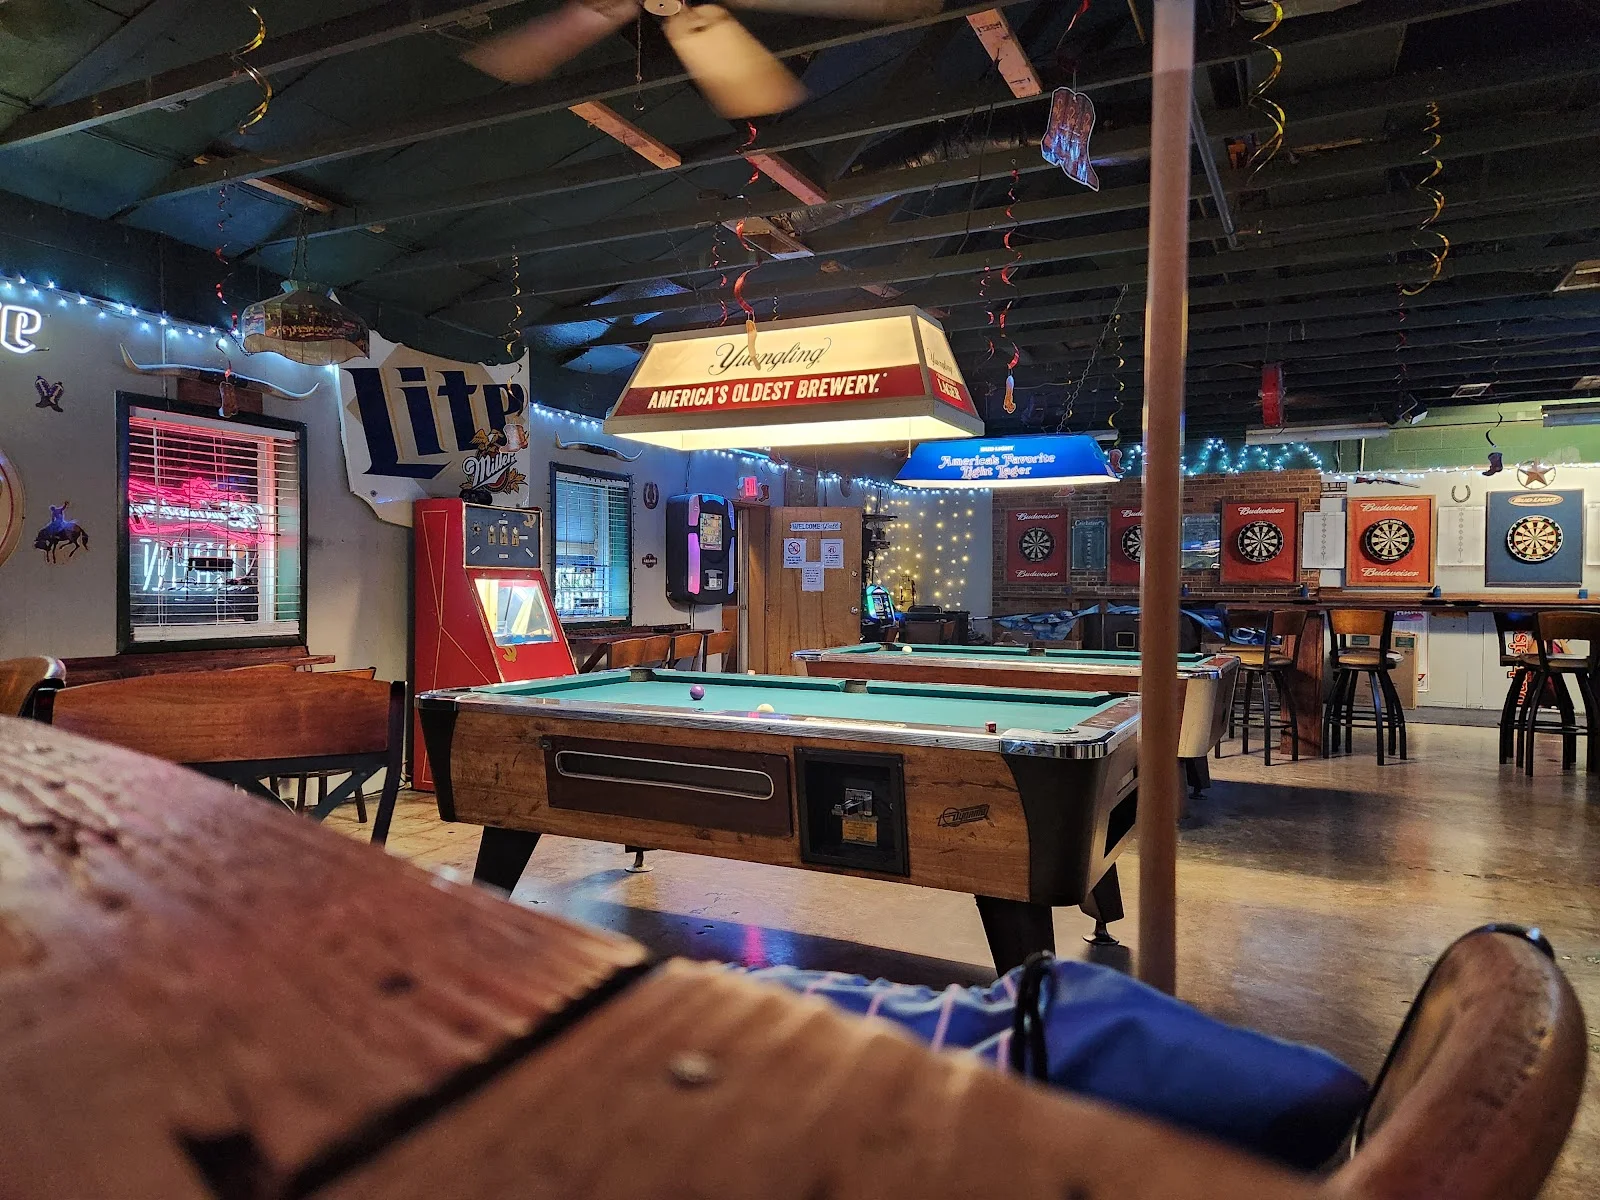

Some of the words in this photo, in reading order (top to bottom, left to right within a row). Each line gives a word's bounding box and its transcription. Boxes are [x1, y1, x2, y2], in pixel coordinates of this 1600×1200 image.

[708, 337, 831, 375] Yuengling
[647, 385, 728, 409] AMERICA'S
[732, 380, 794, 403] OLDEST
[938, 455, 999, 469] America's
[1001, 452, 1056, 466] Favorite
[462, 452, 516, 488] Miller
[960, 465, 993, 480] Light
[996, 464, 1032, 479] Lager
[1237, 506, 1285, 516] Budweiser
[1360, 502, 1419, 512] Budweiser
[1016, 512, 1060, 521] Budweiser
[1015, 569, 1059, 578] Budweiser
[1361, 567, 1420, 577] Budweiser
